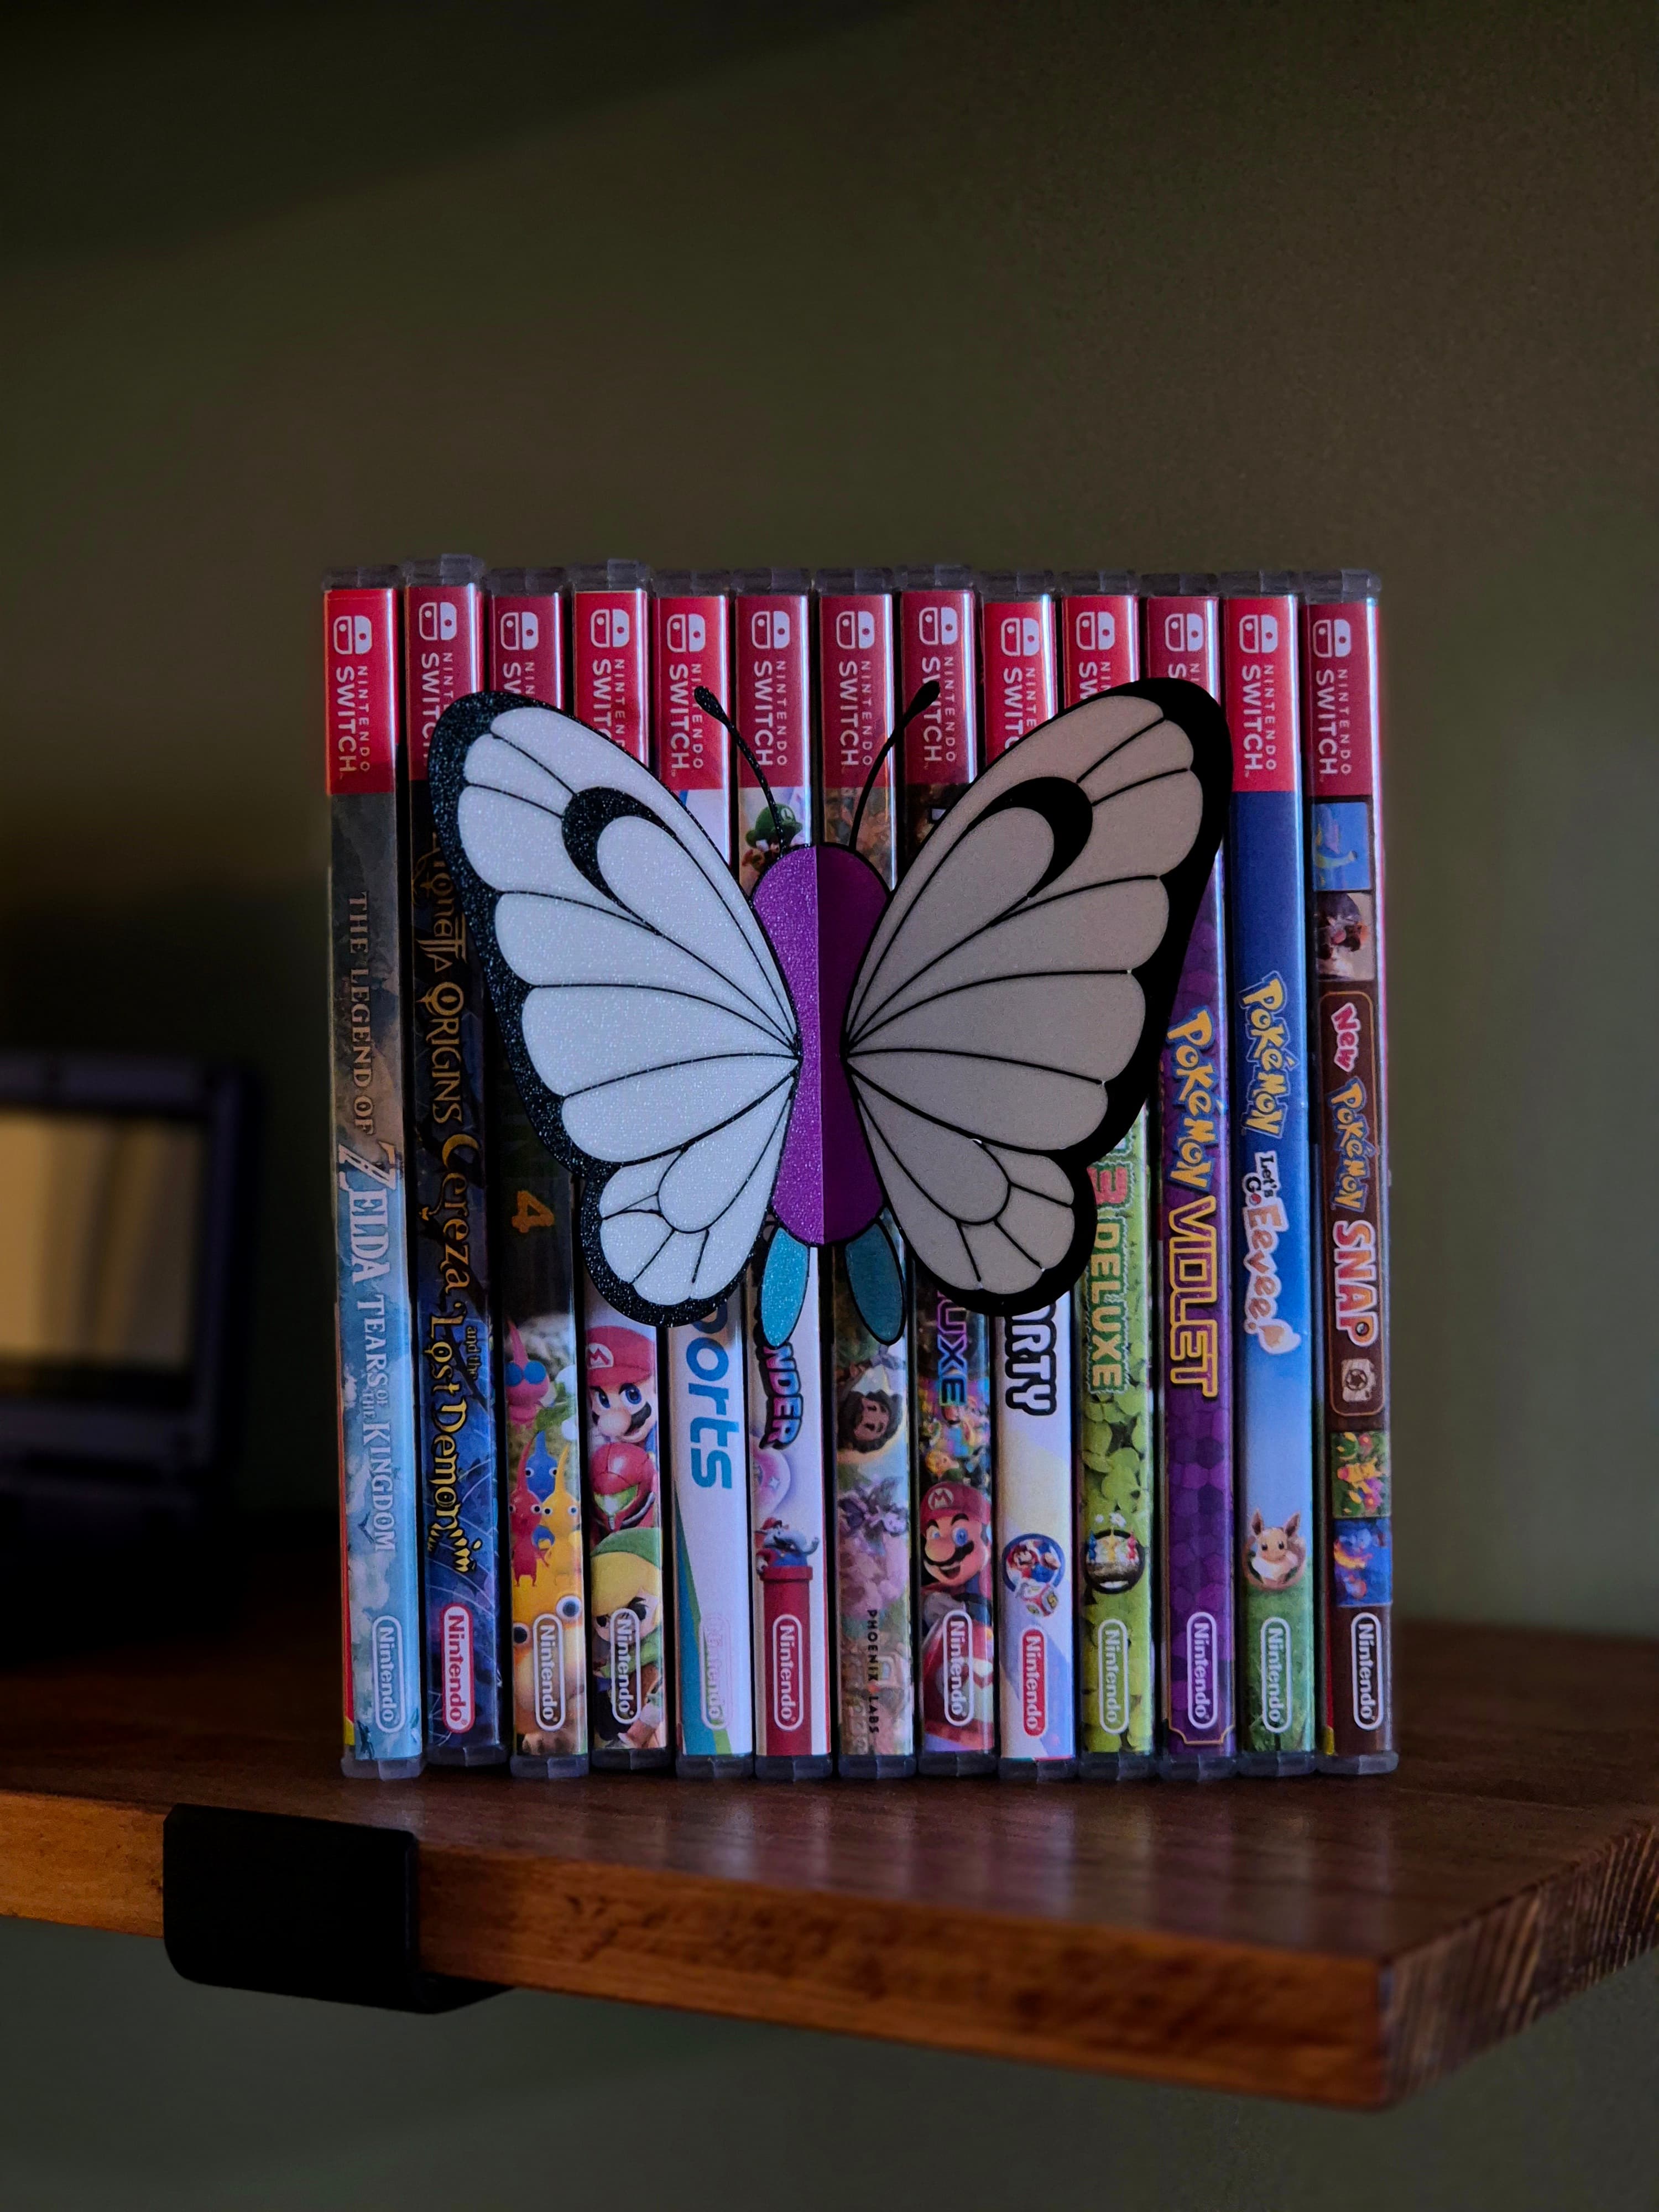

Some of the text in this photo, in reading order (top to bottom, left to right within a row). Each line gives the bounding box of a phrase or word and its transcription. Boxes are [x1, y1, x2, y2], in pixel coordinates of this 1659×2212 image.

[336, 666, 357, 773] SWITCH
[357, 665, 371, 773] NINTENDO
[443, 653, 453, 712] NINT
[592, 659, 612, 738] SWIT
[614, 659, 625, 747] NINTEN
[669, 664, 690, 768] SWITCH
[692, 664, 703, 769] NITENDO
[754, 661, 773, 766] SWITCH
[776, 660, 788, 766] NINTENDO
[839, 661, 859, 765] SWITCH
[861, 661, 873, 765] NINTENDO
[944, 656, 956, 762] NINTENDO
[1003, 667, 1022, 748] SWIT
[1026, 667, 1037, 727] NINTE
[1241, 665, 1263, 771] SWITCH
[1264, 665, 1277, 770] NINTENDO
[1316, 669, 1338, 775] SWITCH
[1337, 669, 1352, 775] NINTENDO
[418, 980, 465, 1125] ORIGINS
[338, 890, 396, 1552] THE LEGEND OF ZELDA TEARS OF THE KINGDOM
[439, 1133, 481, 1295] Cereza
[510, 1190, 555, 1234] 4
[1086, 1166, 1128, 1387] 3 DELUXE
[1168, 1196, 1218, 1398] VIOLET
[1333, 1220, 1379, 1347] SNAP
[426, 1313, 463, 1395] Lost
[465, 1327, 481, 1353] and
[937, 1292, 967, 1405] UXE
[1006, 1305, 1056, 1413] RTY
[686, 1301, 739, 1489] orts
[760, 1341, 804, 1447] NDER
[428, 1397, 470, 1571] Demon
[379, 1626, 399, 1723] Nintendo
[448, 1615, 467, 1723] Nintendo
[540, 1624, 557, 1722] Nintendo
[616, 1619, 633, 1714] Nintendo
[779, 1624, 797, 1721] Nintendo
[868, 1609, 879, 1734] PHOENIX LABS
[950, 1620, 966, 1717] Nintendo
[1026, 1635, 1043, 1730] Nintendo
[1105, 1629, 1119, 1723] Nintendo
[1193, 1623, 1212, 1719] Nintendo
[1267, 1627, 1285, 1723] Nintendo
[1358, 1623, 1376, 1721] Nintendo
